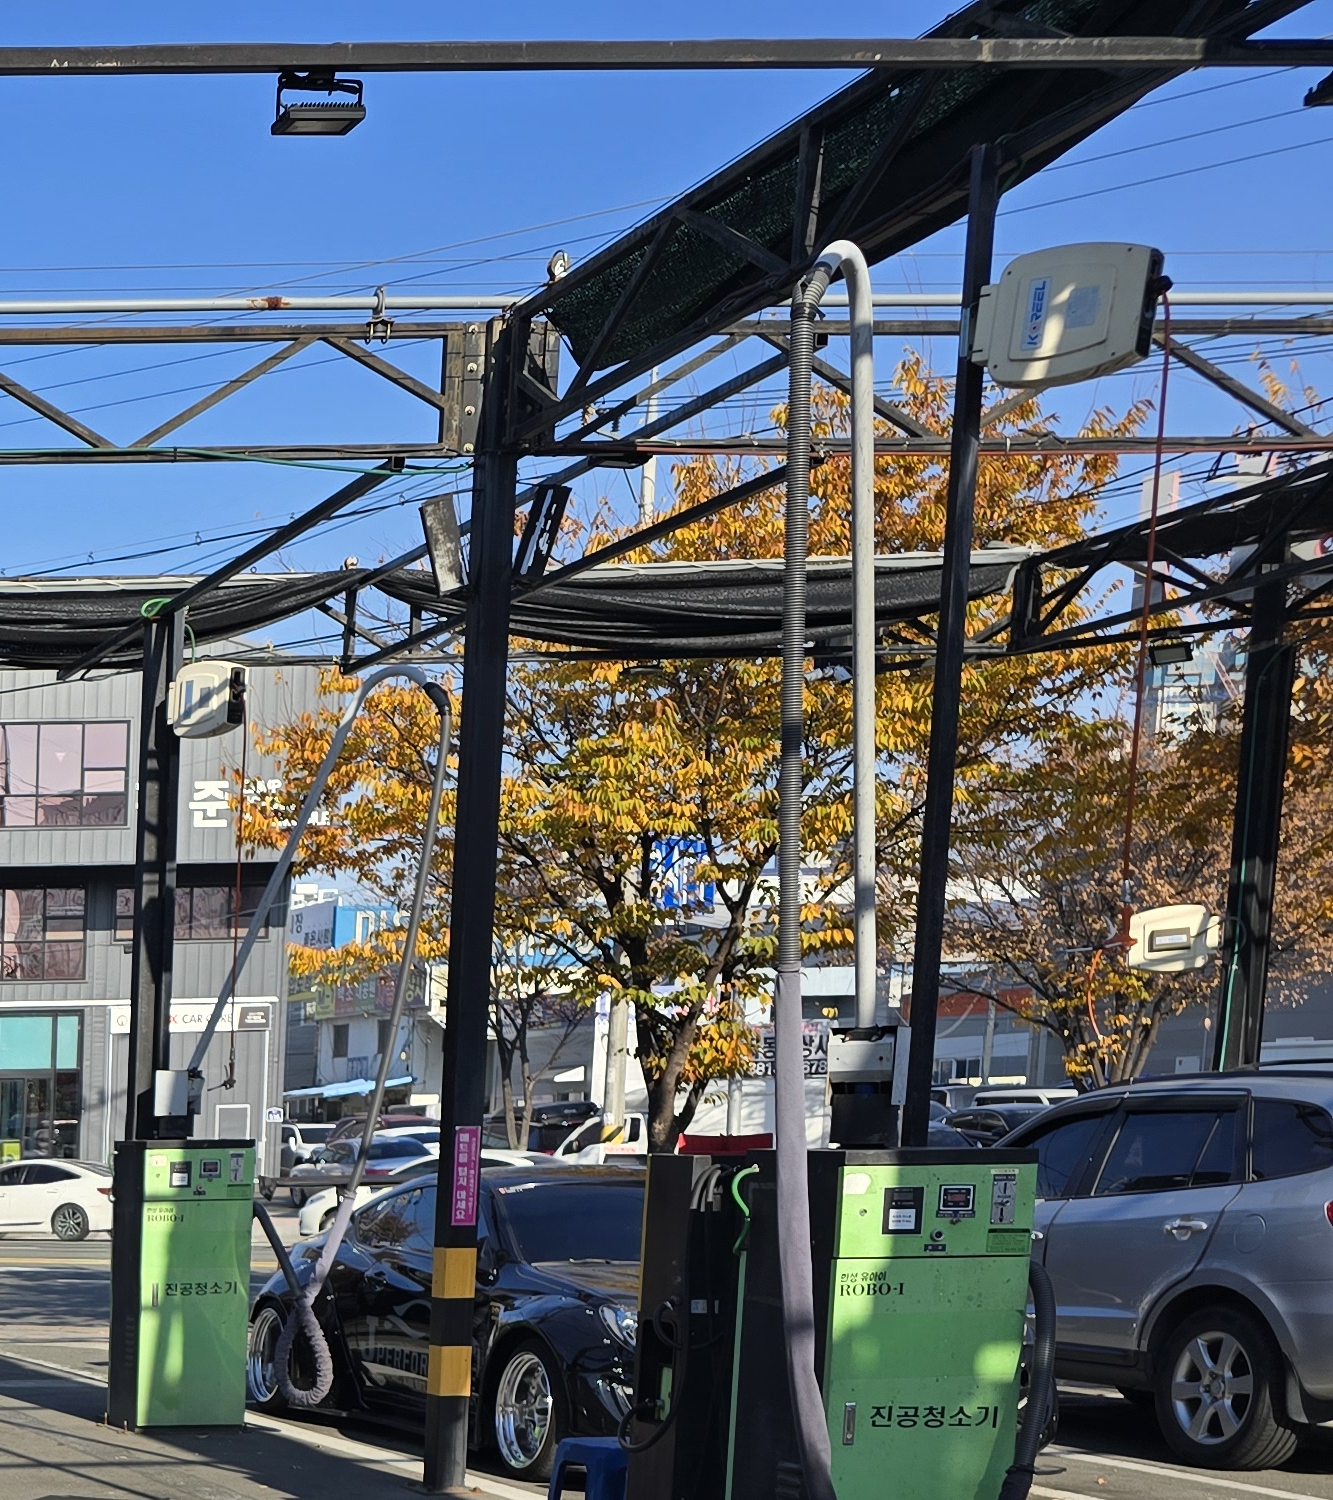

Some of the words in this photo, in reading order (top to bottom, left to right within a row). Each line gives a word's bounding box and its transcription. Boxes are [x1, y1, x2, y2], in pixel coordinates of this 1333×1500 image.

[189, 781, 230, 828] 준
[182, 1014, 203, 1024] CAR
[206, 1013, 233, 1024] CRE
[165, 1281, 238, 1297] 진공청소기
[839, 1282, 905, 1297] ROBO-I
[869, 1405, 999, 1429] 진공청소기
